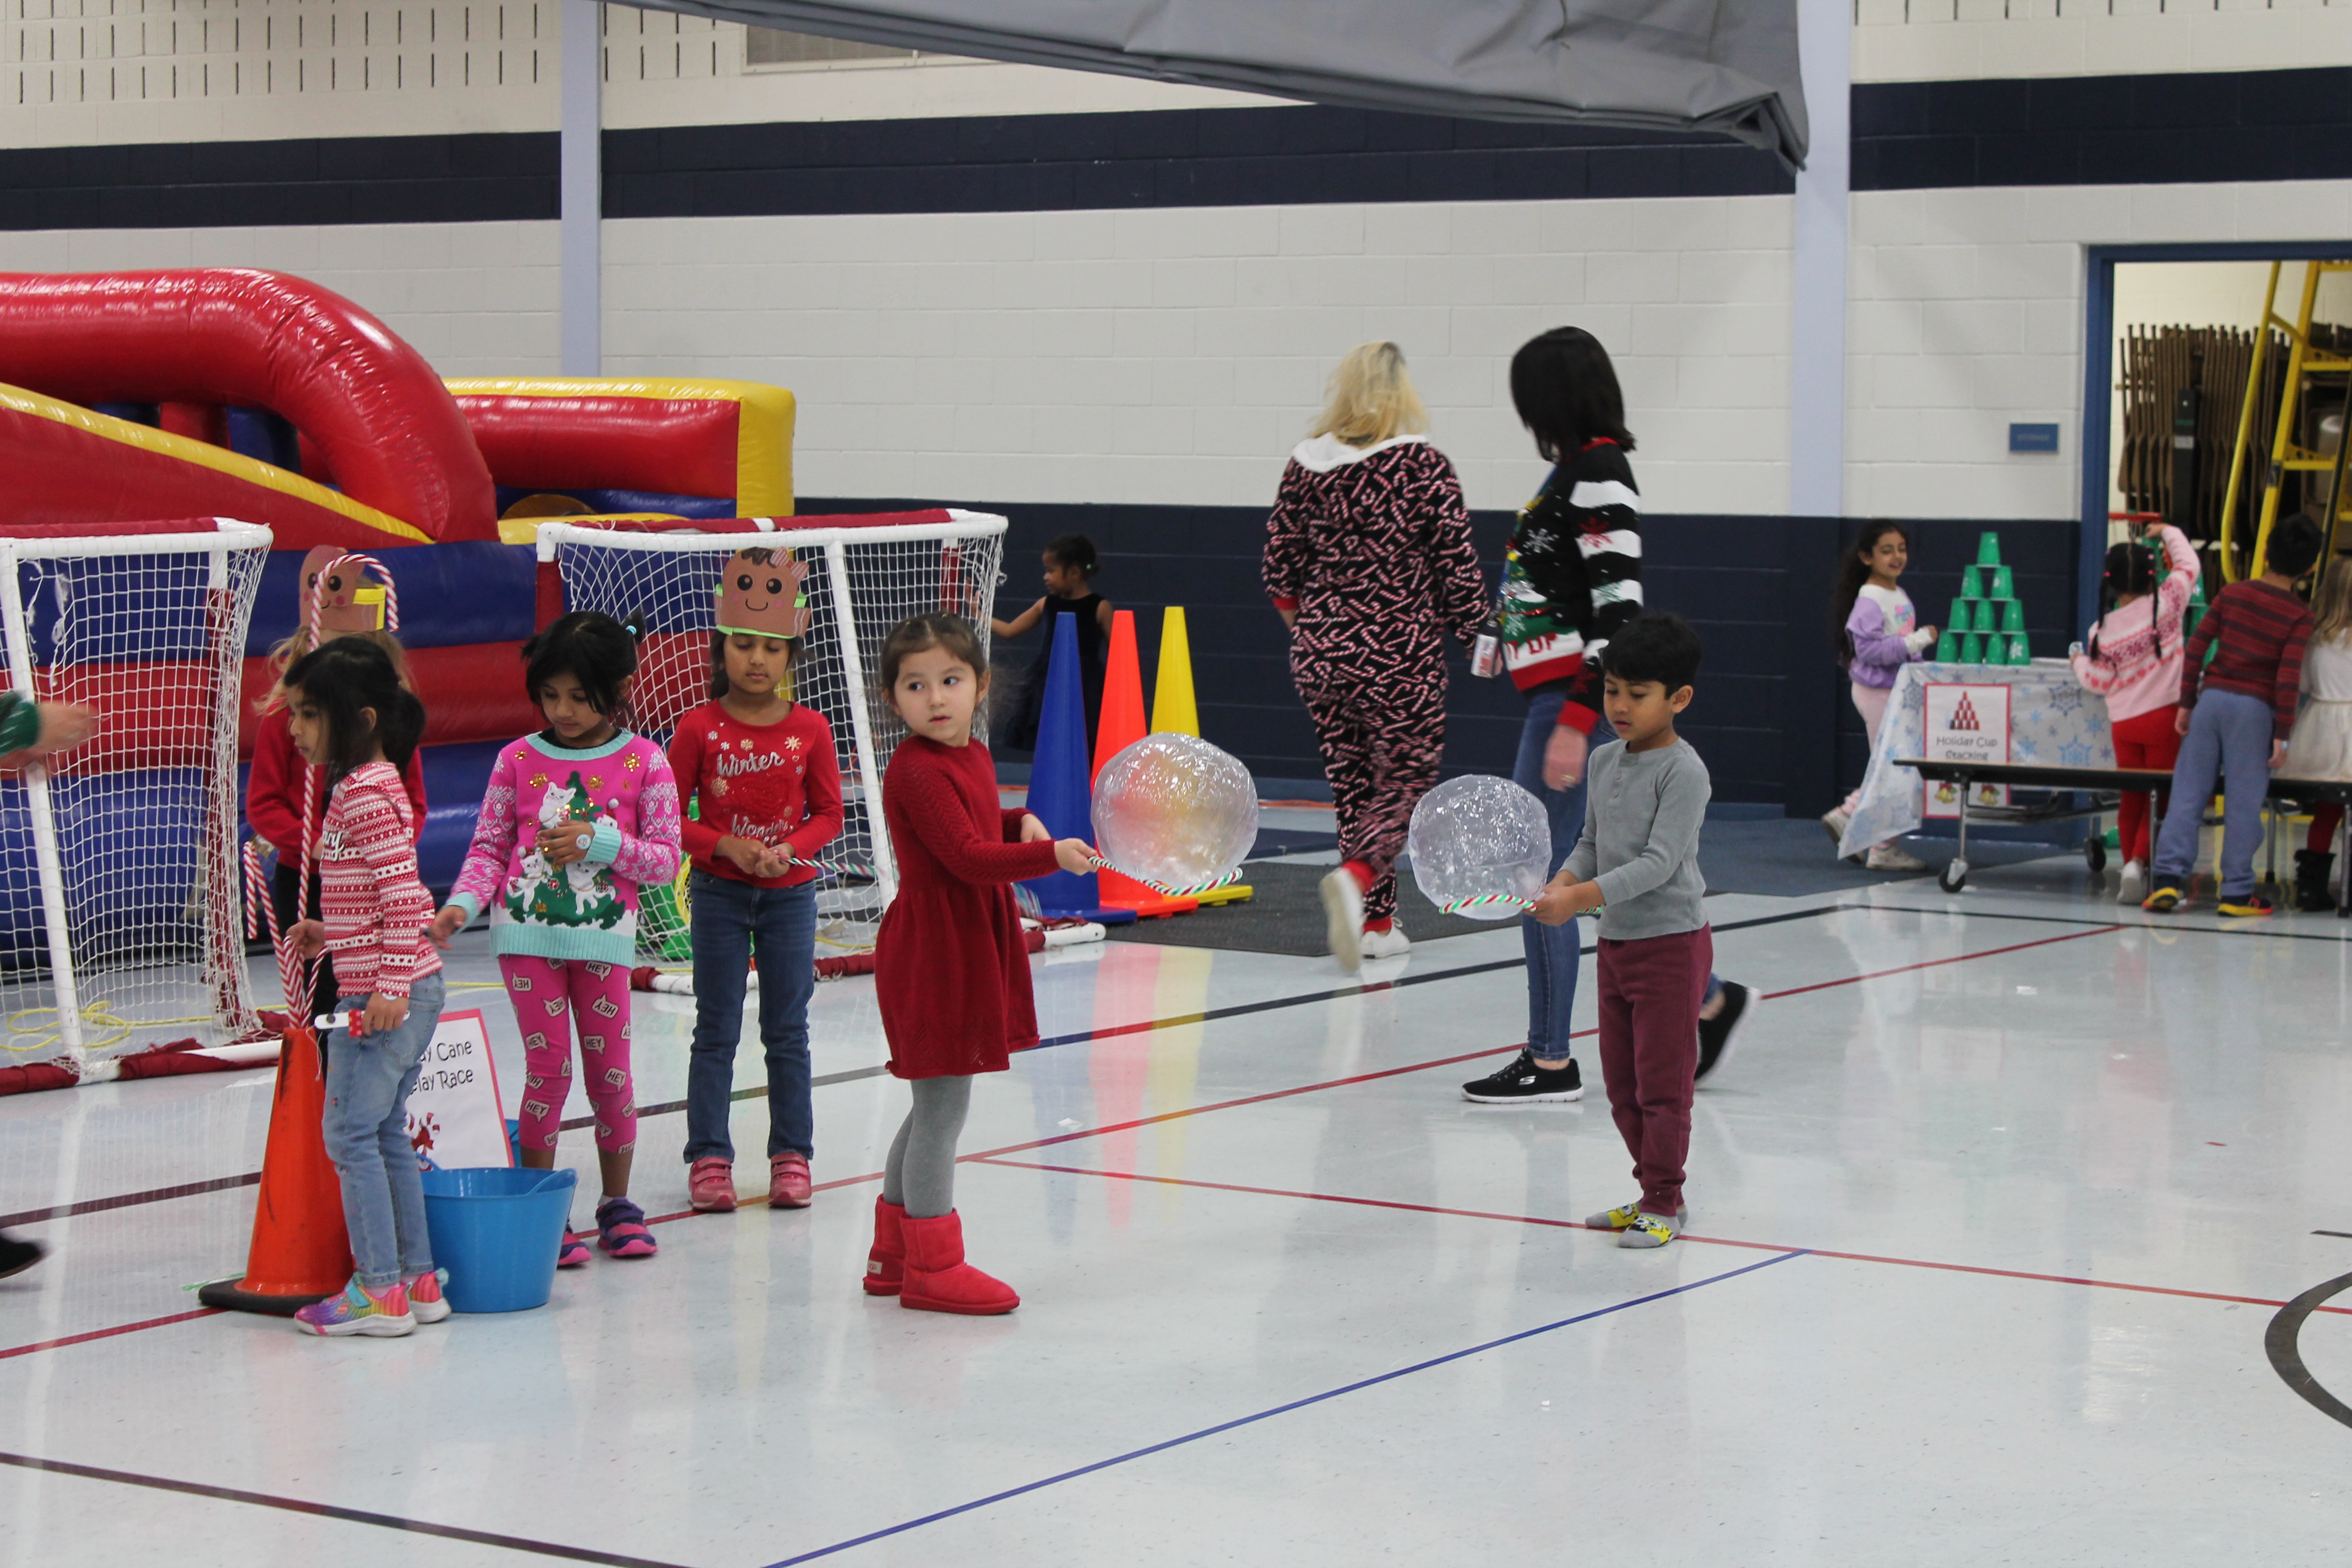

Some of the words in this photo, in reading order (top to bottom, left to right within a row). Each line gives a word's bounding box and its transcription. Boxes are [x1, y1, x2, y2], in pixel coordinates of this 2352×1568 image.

[1527, 632, 1558, 654] UP
[1936, 736, 1974, 746] Holiday
[1976, 737, 1997, 747] Cup
[717, 751, 785, 777] Winter
[588, 962, 608, 974] HEY
[514, 979, 529, 988] HEY
[595, 1001, 616, 1015] HEY
[529, 1035, 542, 1046] HEY
[586, 1038, 601, 1048] HEY
[437, 1041, 472, 1061] Cane
[436, 1069, 473, 1090] Race
[607, 1070, 625, 1084] HEY
[526, 1101, 547, 1115] HEY
